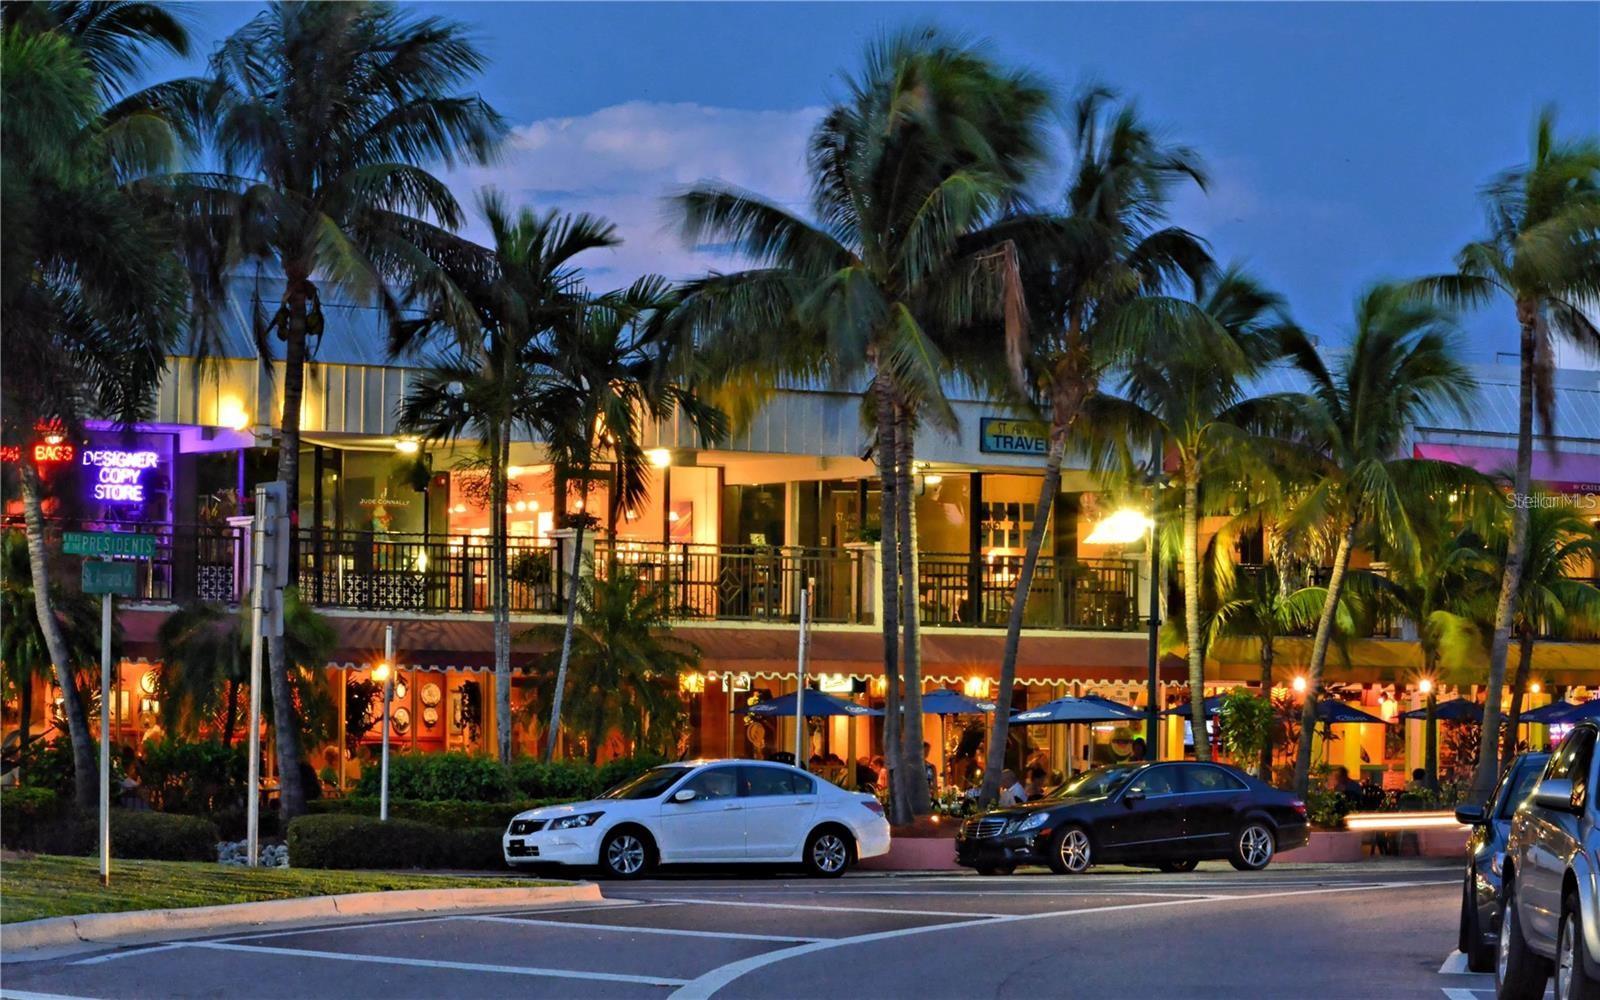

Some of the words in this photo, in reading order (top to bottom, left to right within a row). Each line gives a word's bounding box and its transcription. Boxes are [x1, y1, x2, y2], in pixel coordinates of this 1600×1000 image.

[82, 450, 158, 468] DESIGNER
[99, 467, 141, 484] COPY
[94, 484, 144, 501] STORE
[82, 536, 152, 553] PRESIDENTS
